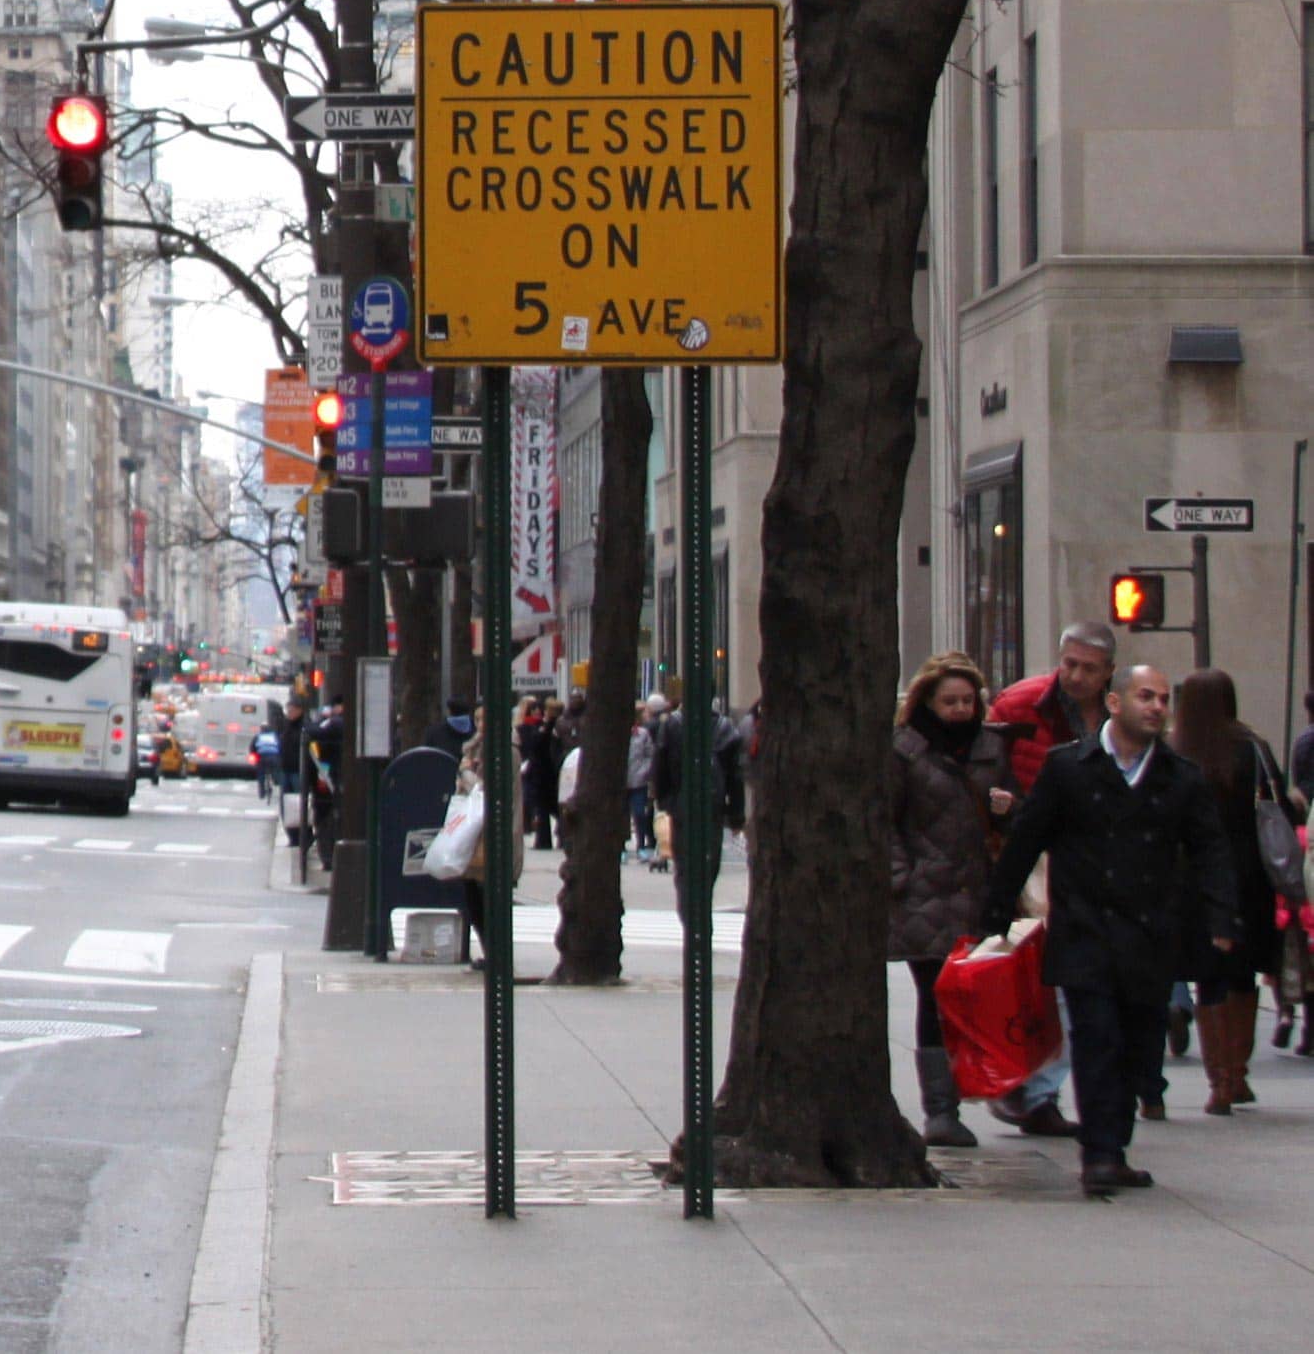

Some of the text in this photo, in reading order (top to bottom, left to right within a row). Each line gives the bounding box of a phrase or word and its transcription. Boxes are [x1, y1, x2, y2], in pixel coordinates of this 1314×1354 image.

[451, 30, 743, 86] CAUTION
[324, 109, 414, 127] ONE WAY
[451, 109, 747, 155] RECESSED
[446, 165, 752, 212] CROSSWALK
[561, 223, 639, 269] ON
[320, 284, 342, 298] BU
[514, 281, 686, 336] 5 AVE
[338, 376, 357, 395] M2
[1174, 508, 1242, 522] ONE WAY
